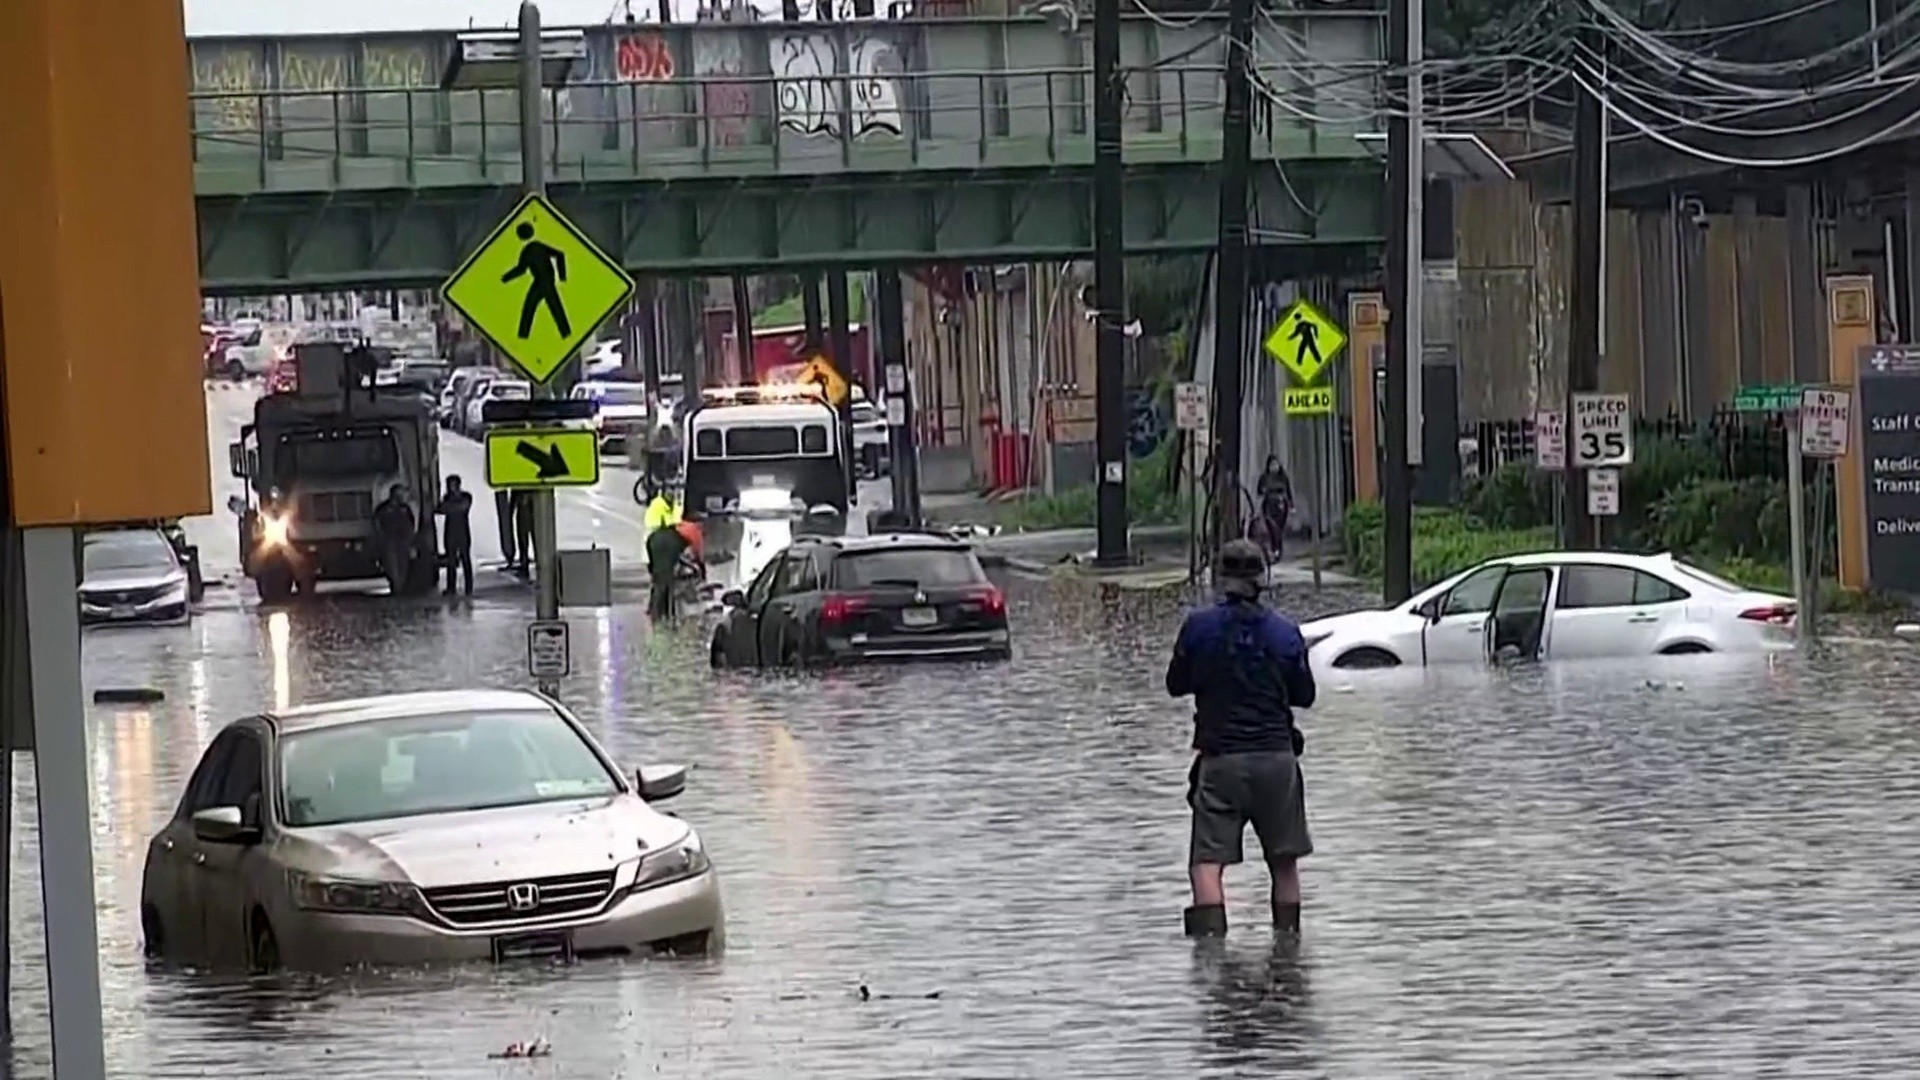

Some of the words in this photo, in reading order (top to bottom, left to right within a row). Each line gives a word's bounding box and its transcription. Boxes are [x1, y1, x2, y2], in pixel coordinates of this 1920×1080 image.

[1287, 392, 1330, 408] AHEAD
[1577, 400, 1626, 413] SPEED
[1818, 393, 1836, 406] NO
[1582, 414, 1620, 429] LIMIT
[1872, 414, 1909, 431] Staff
[1580, 432, 1625, 460] 35
[1874, 456, 1920, 472] Medic
